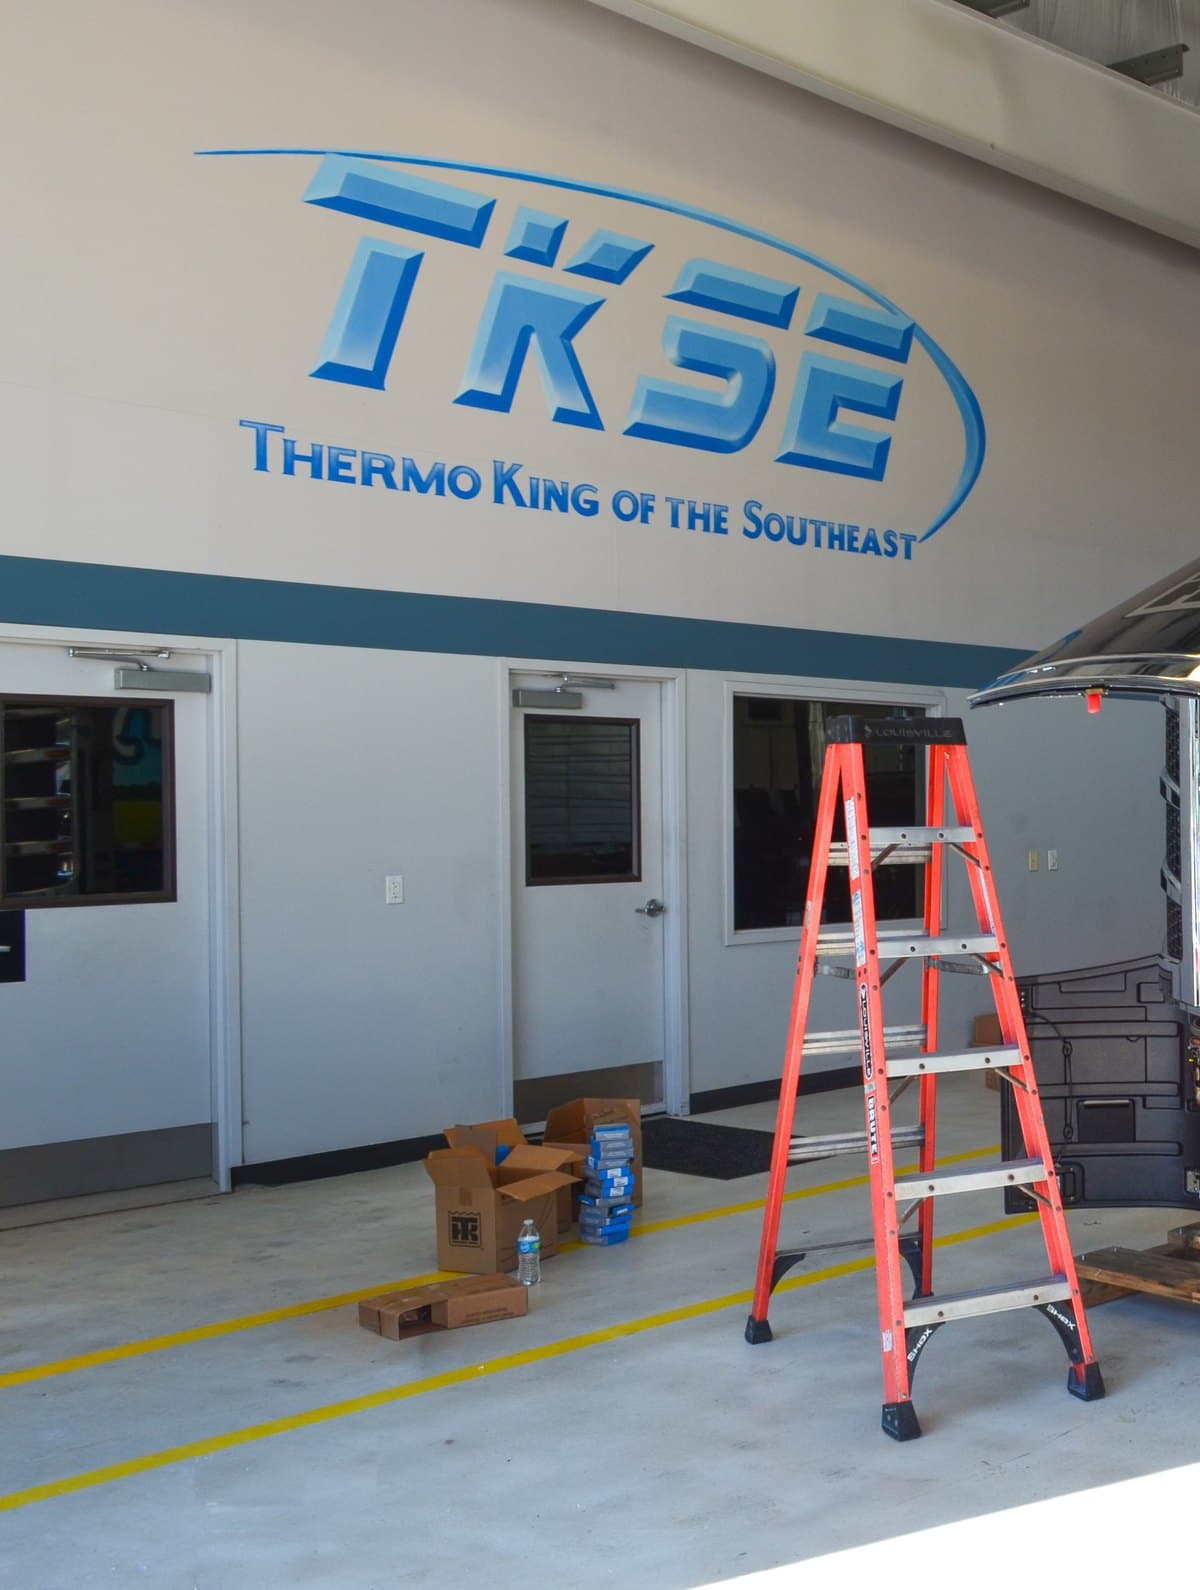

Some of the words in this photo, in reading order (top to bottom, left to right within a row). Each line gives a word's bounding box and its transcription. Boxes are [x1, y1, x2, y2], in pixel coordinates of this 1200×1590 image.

[303, 153, 915, 482] TKSE
[239, 419, 482, 500] THERMO
[493, 459, 600, 517] KING
[611, 489, 656, 525] OF
[664, 496, 729, 535] THE
[742, 499, 917, 560] SOUTHEAST
[876, 729, 953, 738] LOUISVILLE
[861, 1000, 872, 1076] LOUISVILLE
[867, 1097, 878, 1154] BRUTE
[907, 1328, 933, 1362] SHOX
[1047, 1303, 1076, 1331] SHOX
